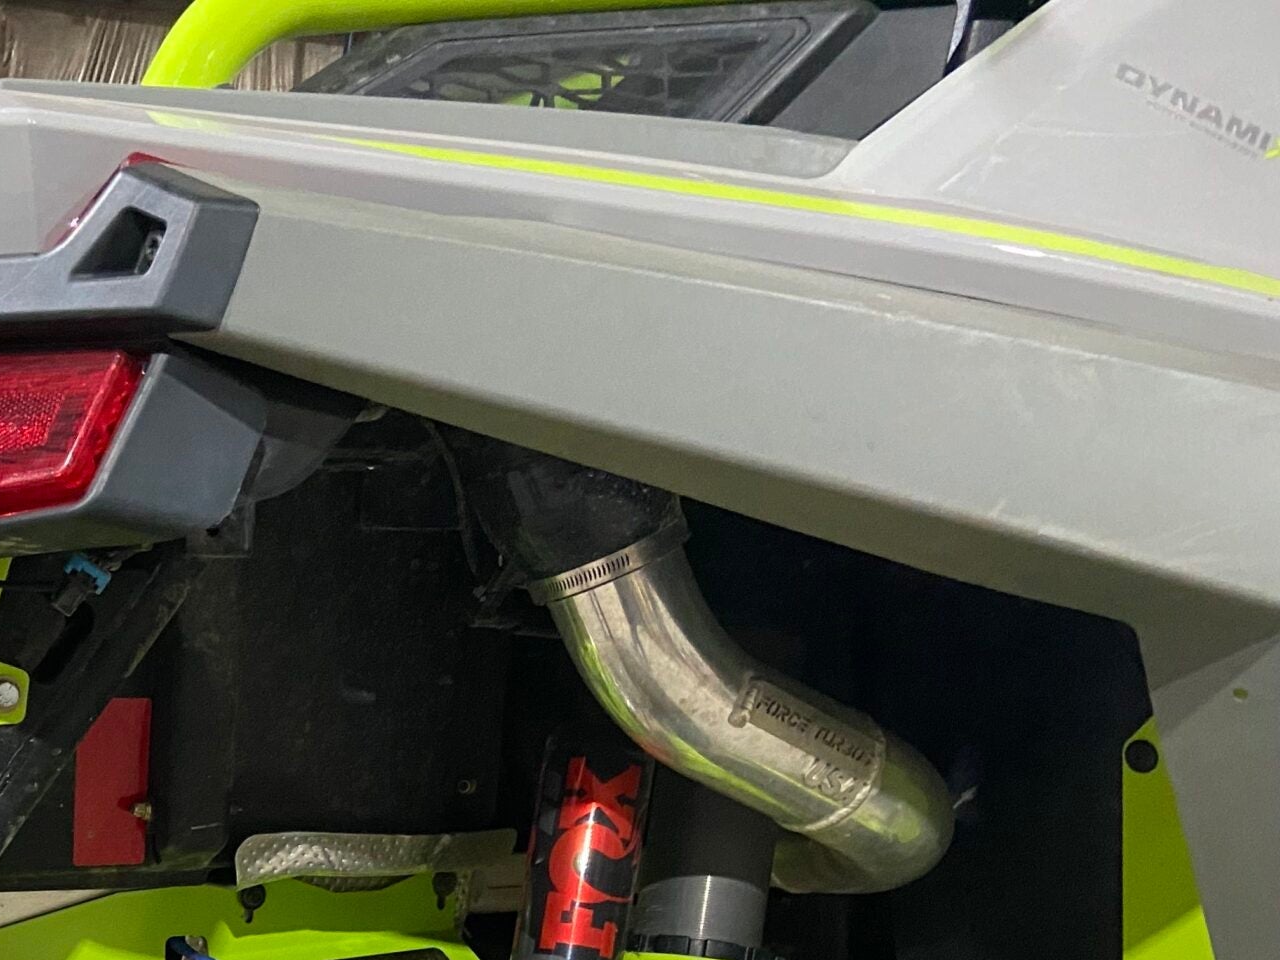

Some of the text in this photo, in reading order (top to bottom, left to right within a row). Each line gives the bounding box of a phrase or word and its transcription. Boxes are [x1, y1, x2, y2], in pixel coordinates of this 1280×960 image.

[1116, 63, 1280, 159] DYNAMI
[755, 697, 812, 733] FORCE
[539, 755, 642, 959] FOX
